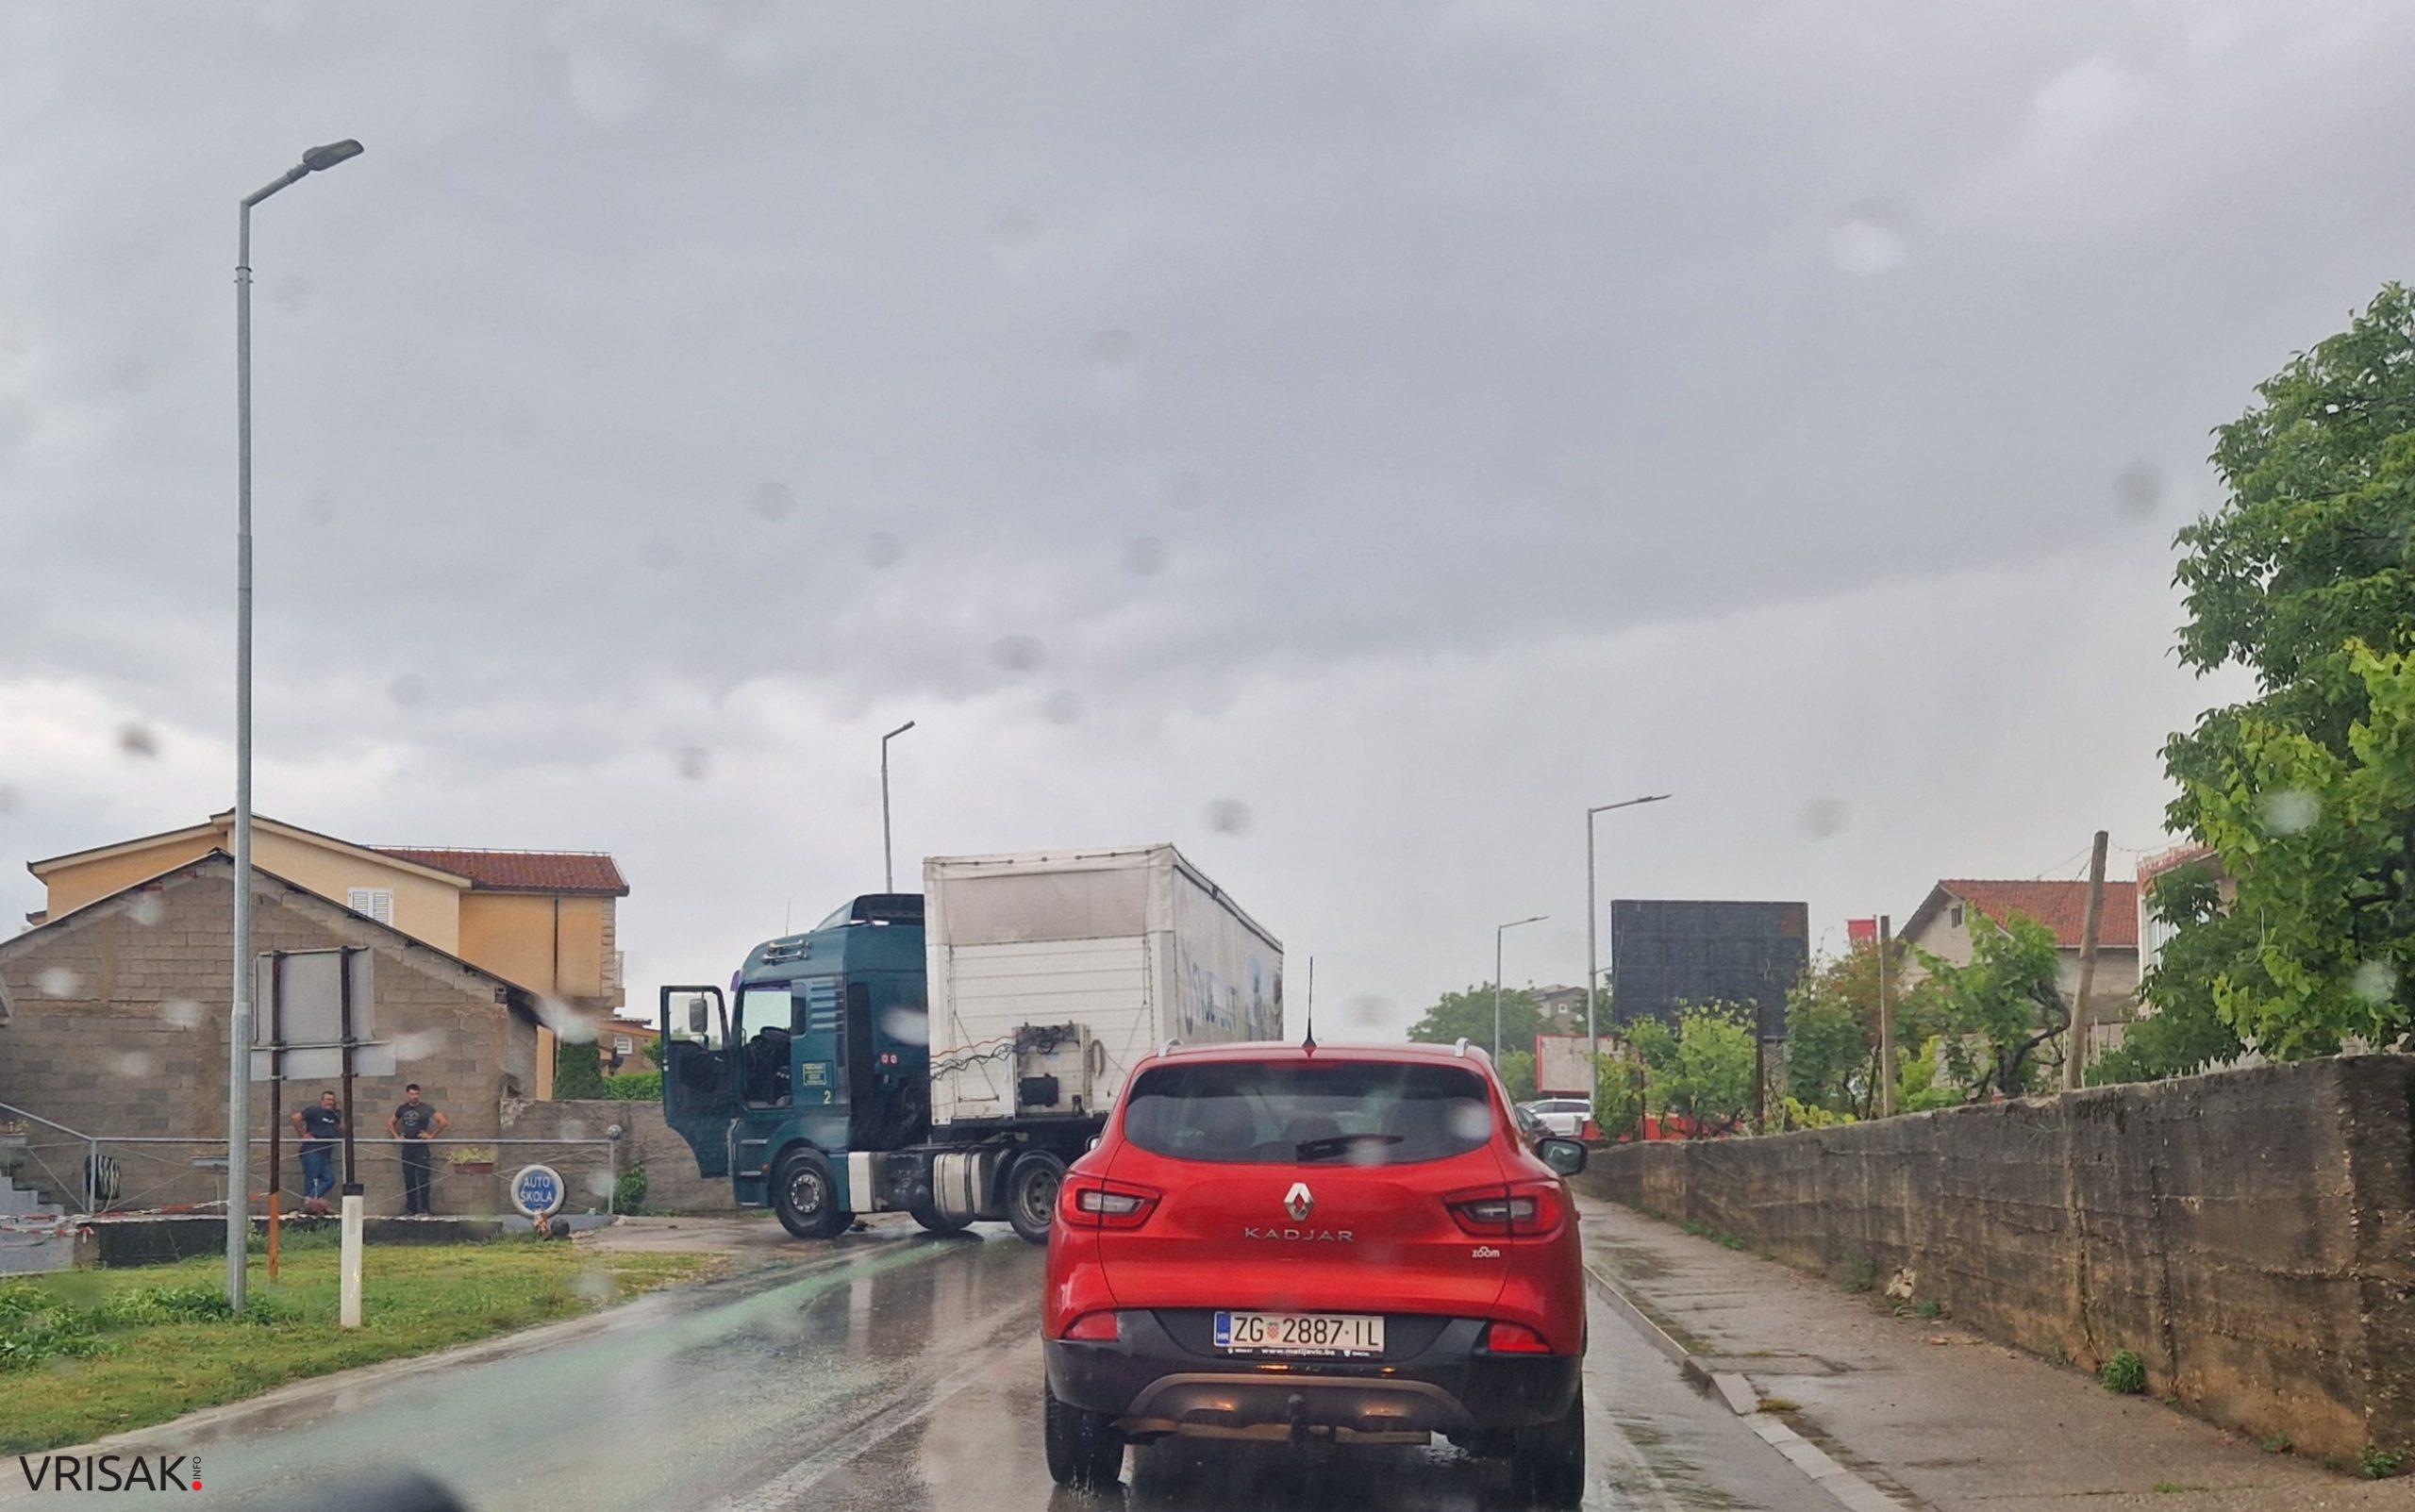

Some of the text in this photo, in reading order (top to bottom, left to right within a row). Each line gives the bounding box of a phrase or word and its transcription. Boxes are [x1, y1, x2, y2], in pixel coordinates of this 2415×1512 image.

[823, 1089, 831, 1105] 2
[522, 1176, 551, 1188] AUTO
[1244, 1227, 1355, 1242] KADJAR
[1234, 1317, 1264, 1342] ZG
